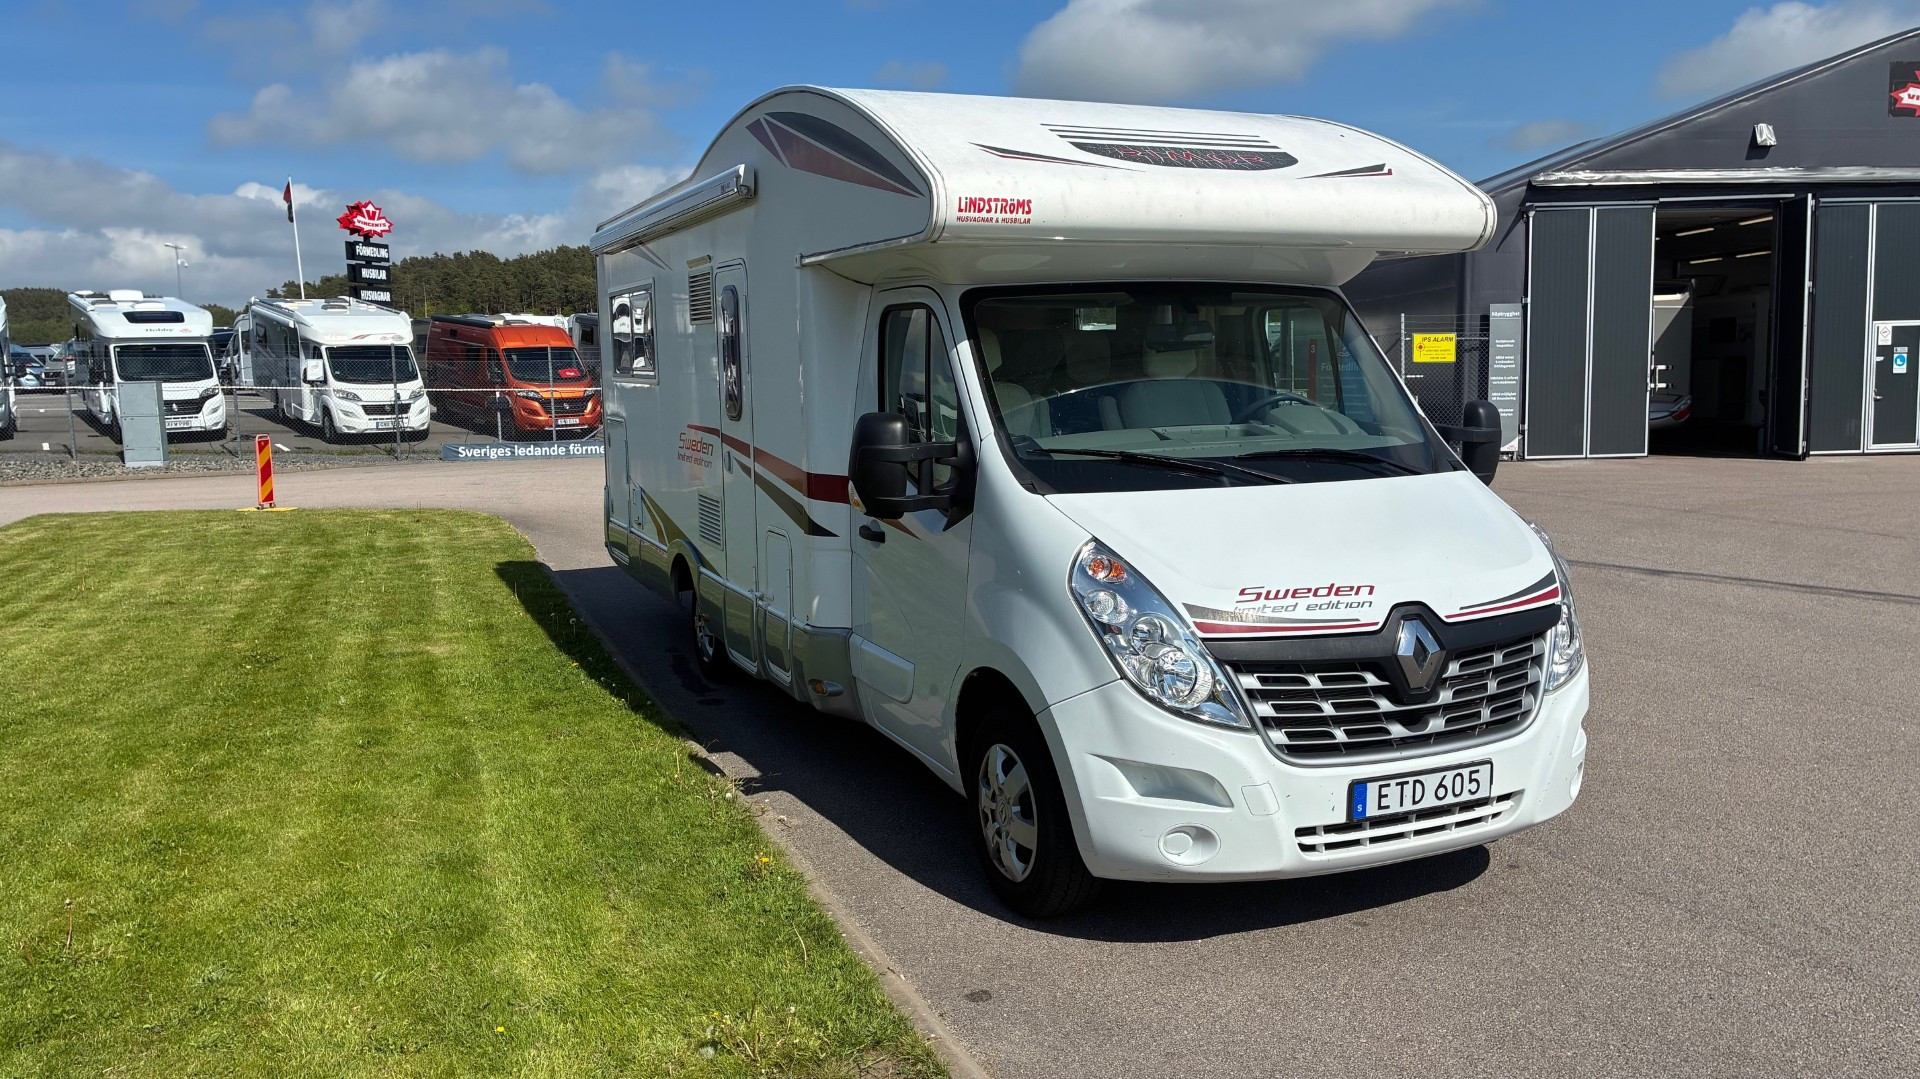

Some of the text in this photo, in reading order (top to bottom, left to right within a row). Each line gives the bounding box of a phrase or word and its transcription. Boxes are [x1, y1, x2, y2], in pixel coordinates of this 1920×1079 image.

[956, 215, 1031, 225] HUSVAGNAR & HUSBILAR
[355, 243, 389, 259] FÖRMEDLING
[361, 267, 387, 280] HUSBILAR
[360, 289, 391, 302] HUSVAGNAR
[1310, 344, 1316, 353] 3
[679, 432, 714, 456] Sweden
[458, 446, 512, 459] Sveriges
[514, 444, 566, 456] ledande
[1235, 583, 1375, 603] Sweden
[1305, 600, 1372, 611] edition
[1378, 769, 1480, 810] ETD 605
[1357, 804, 1363, 812] S
